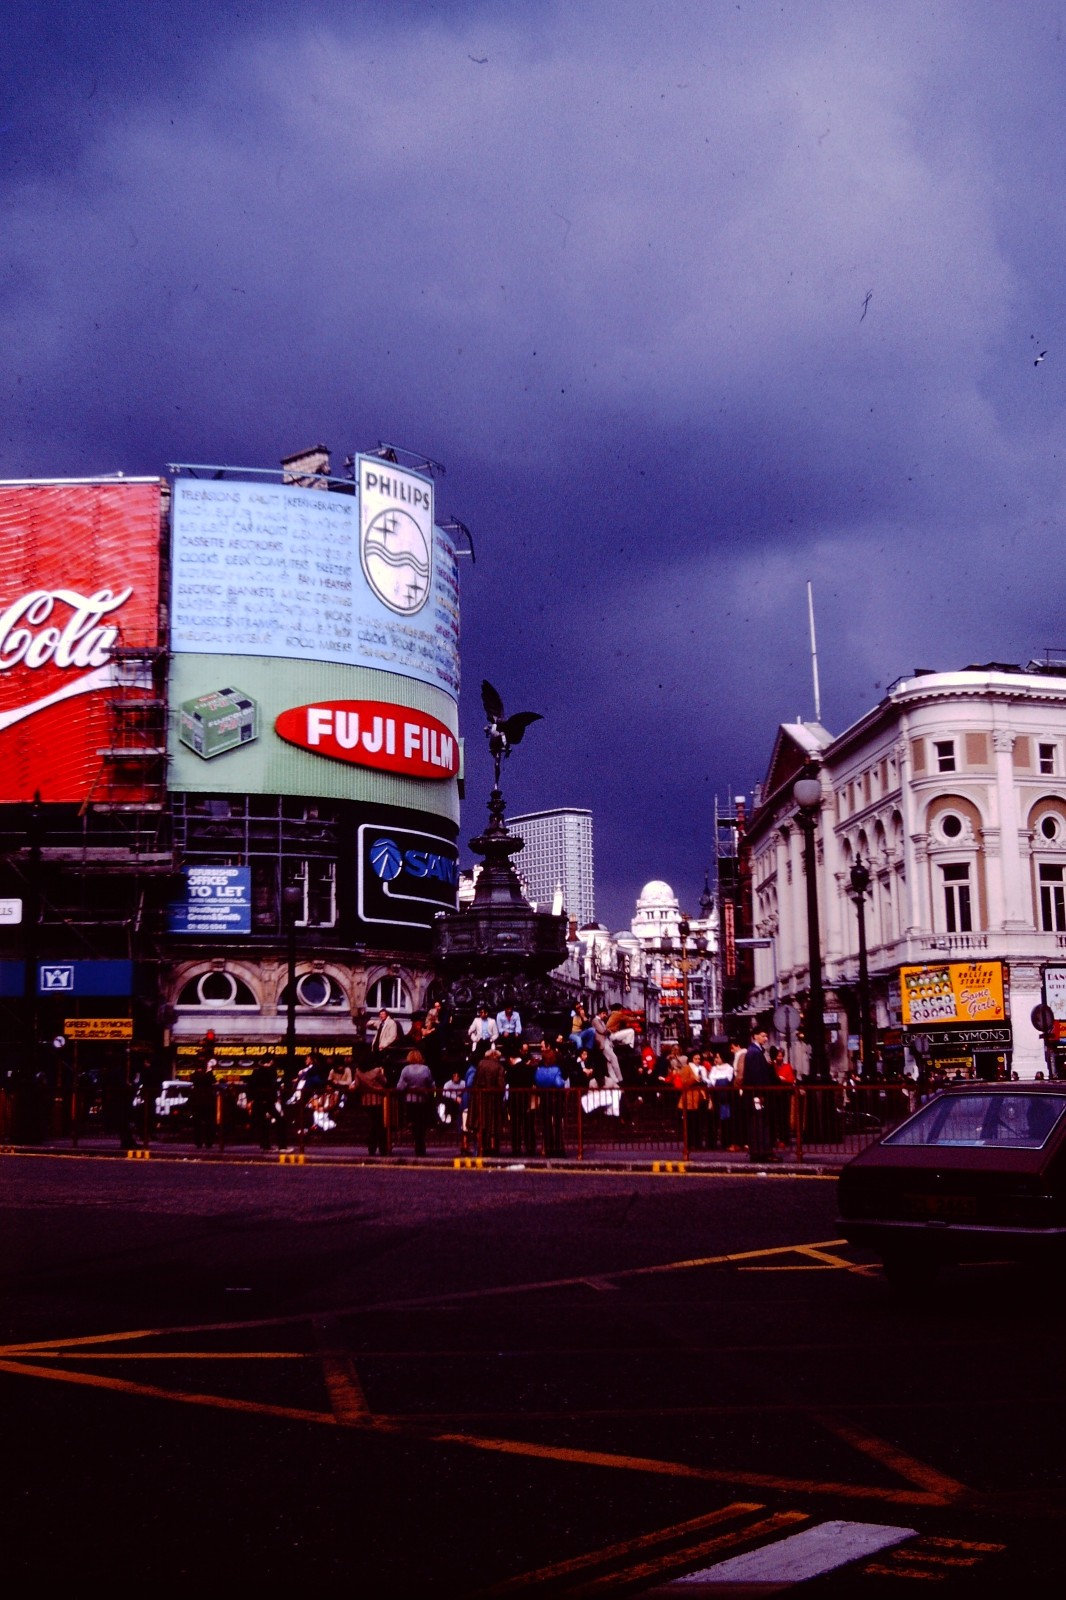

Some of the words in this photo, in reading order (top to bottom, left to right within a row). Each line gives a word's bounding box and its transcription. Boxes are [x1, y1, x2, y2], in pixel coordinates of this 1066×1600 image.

[365, 471, 430, 511] PHILIPS
[179, 535, 225, 548] CASSETTE
[0, 586, 134, 670] Cola
[307, 707, 396, 755] FUJI
[404, 721, 453, 771] FILM
[187, 876, 229, 886] OFFICES
[187, 885, 213, 897] TO
[216, 886, 246, 897] LET
[958, 970, 993, 979] ROLLING
[960, 977, 992, 985] STONES
[960, 989, 990, 1004] Some
[967, 998, 996, 1018] Girls
[943, 1033, 949, 1042] &
[958, 1031, 1005, 1041] SYMONS
